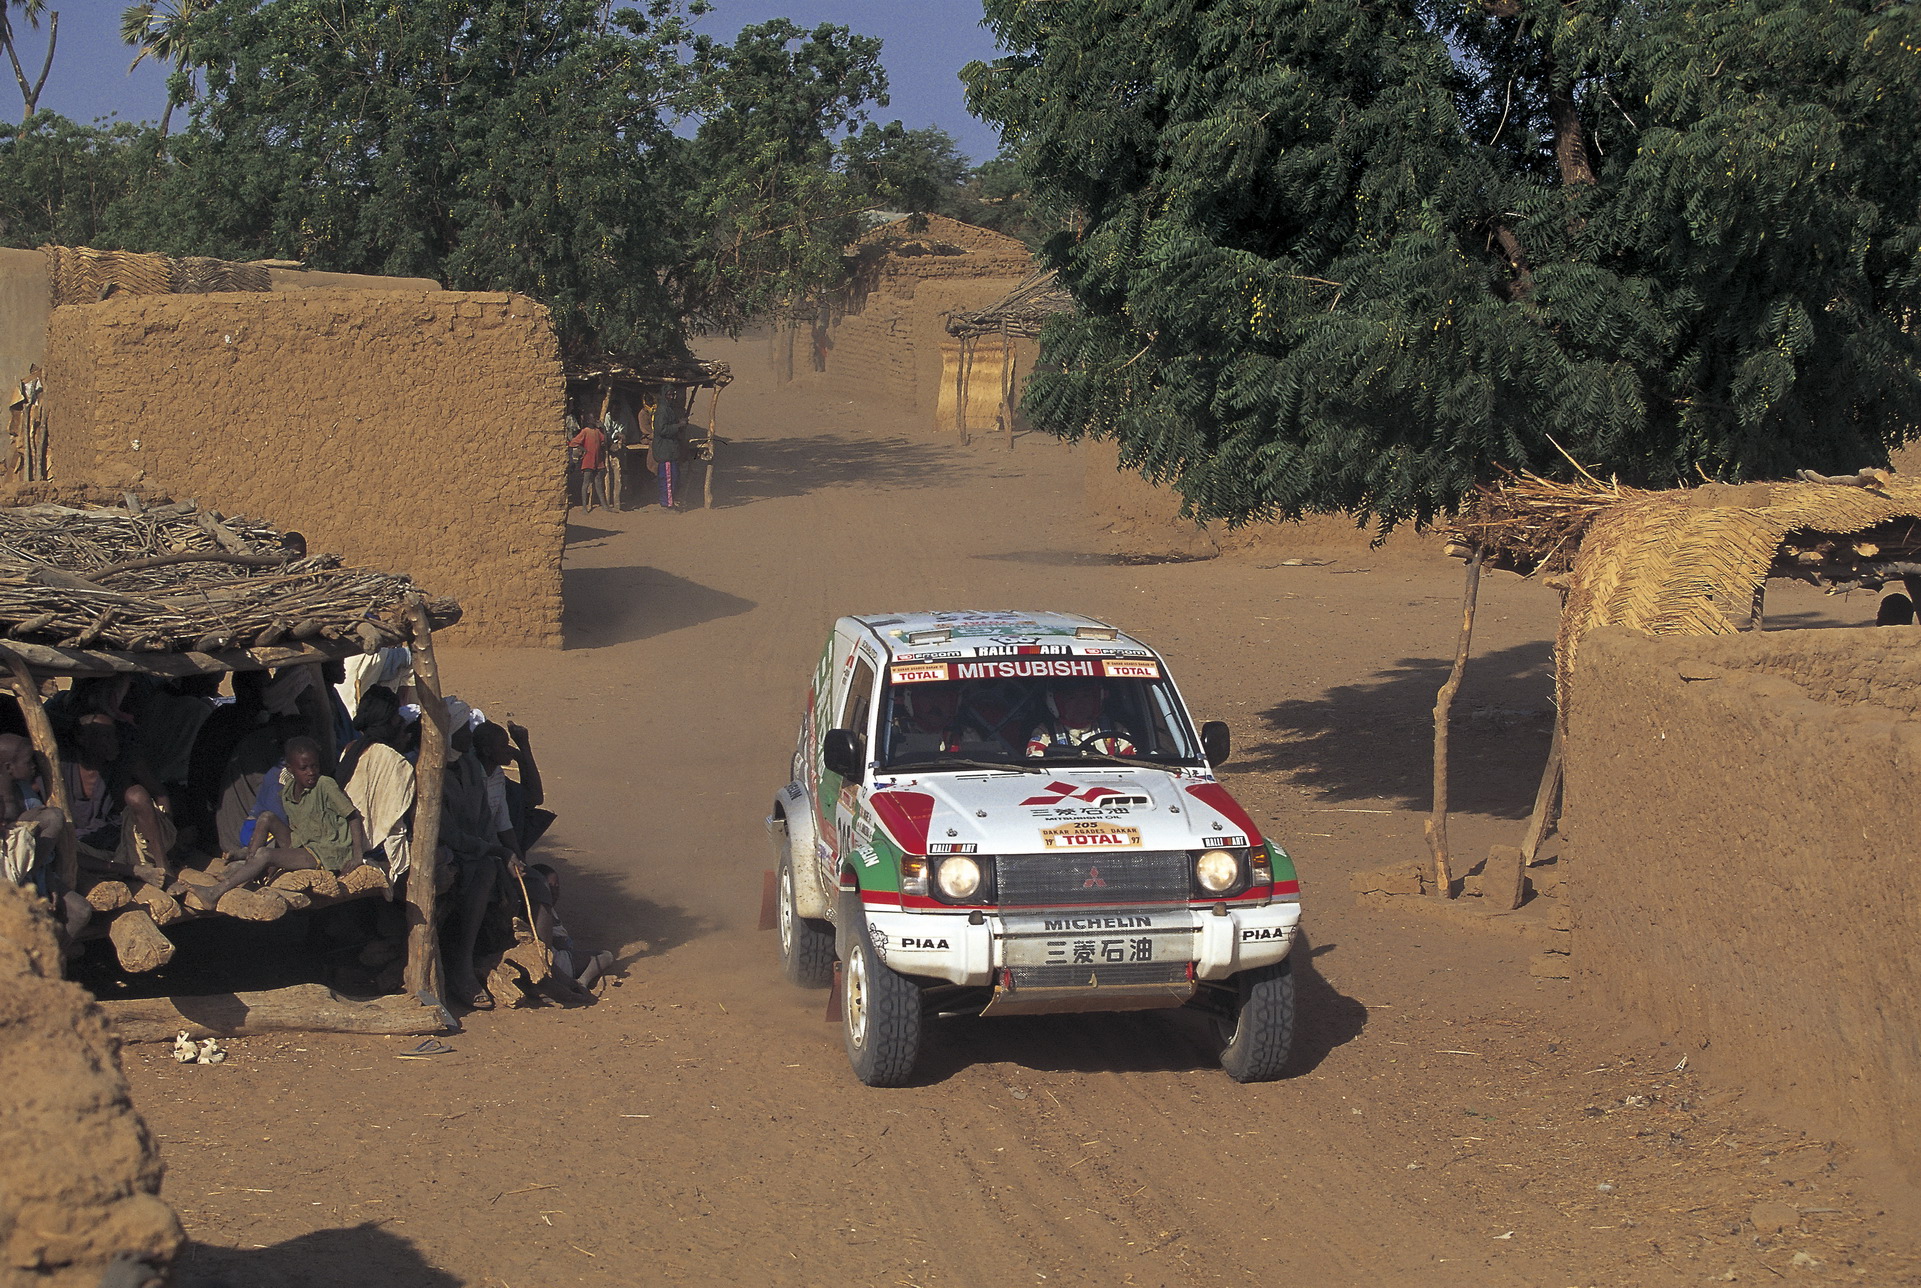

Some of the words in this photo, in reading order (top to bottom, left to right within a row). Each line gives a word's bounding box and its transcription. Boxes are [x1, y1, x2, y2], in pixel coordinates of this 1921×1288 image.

[978, 646, 1018, 657] RALLI
[1040, 645, 1067, 655] ART
[899, 670, 939, 681] TOTAL
[957, 661, 1094, 679] MITSUBISHI
[1113, 667, 1151, 676] TOTAL
[1062, 834, 1123, 845] TOTAL
[1131, 836, 1140, 844] 97
[1205, 837, 1224, 847] RALLI
[1231, 836, 1244, 846] ART
[931, 843, 952, 853] RALLI
[960, 843, 976, 853] ART
[1044, 917, 1152, 930] MICHELIN
[1242, 927, 1283, 941] PIAA
[901, 938, 950, 949] PIAA
[1045, 937, 1153, 964] 三菱石油
